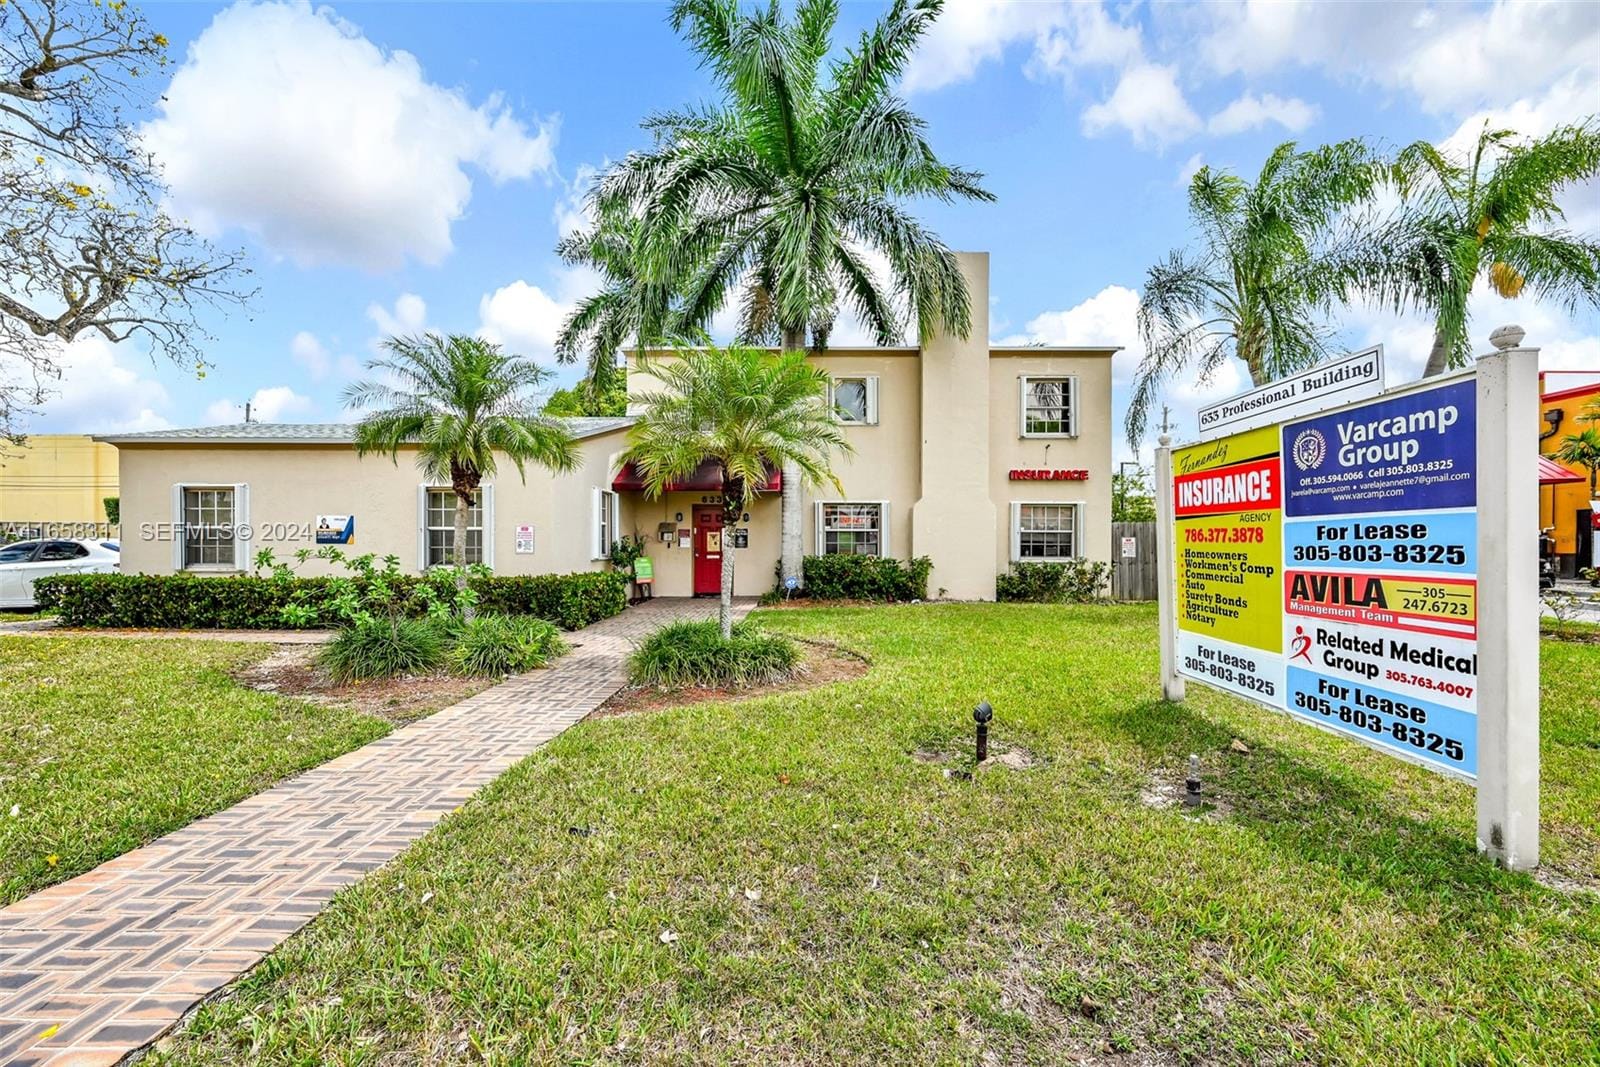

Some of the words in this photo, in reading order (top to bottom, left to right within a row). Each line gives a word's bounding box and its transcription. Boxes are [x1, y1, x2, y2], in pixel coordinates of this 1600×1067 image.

[1201, 410, 1220, 425] 633
[1222, 385, 1296, 418] Professional
[1302, 361, 1374, 394] Building
[1337, 405, 1459, 444] Varcamp
[1179, 440, 1228, 476] Fernandez
[1338, 438, 1420, 467] Group
[1008, 469, 1089, 481] INSURANCE
[1313, 471, 1364, 485] 305.594.0066
[1368, 466, 1385, 478] Cell
[1386, 459, 1454, 476] 305.803.8325
[1359, 471, 1471, 490] varelajeannette7@gmail.com
[1178, 469, 1272, 508] INSURANCE
[1332, 488, 1404, 501] www.varcamp.com
[1240, 513, 1272, 523] AGENCY
[1185, 527, 1264, 543] 786.377.3878
[1316, 525, 1348, 541] For
[1354, 523, 1427, 541] Lease
[1185, 549, 1248, 561] Homeowners
[1293, 544, 1466, 566] 305-803-8325
[1185, 559, 1238, 572] Workmen's
[1240, 562, 1274, 577] Comp
[1185, 569, 1244, 584] Commercial
[1185, 580, 1205, 591] Auto
[1290, 573, 1389, 609] AVILA
[1422, 587, 1446, 599] 305
[1186, 591, 1213, 604] Surety
[1215, 594, 1248, 608] Bonds
[1186, 600, 1239, 618] Agriculture
[1403, 598, 1468, 616] 247.6723
[1186, 610, 1216, 627] Notary
[1290, 601, 1356, 618] Management
[1360, 609, 1394, 623] Team
[1198, 645, 1215, 659] For
[1217, 649, 1256, 673] Lease
[1317, 628, 1384, 657] Related
[1390, 640, 1477, 676] Medical
[1185, 656, 1275, 697] 305-803-8325
[1323, 649, 1380, 680] Group
[1386, 669, 1474, 699] 305.763.4007
[1318, 678, 1350, 701] For
[1355, 687, 1426, 724] Lease
[1294, 691, 1464, 762] 305-803-8325
